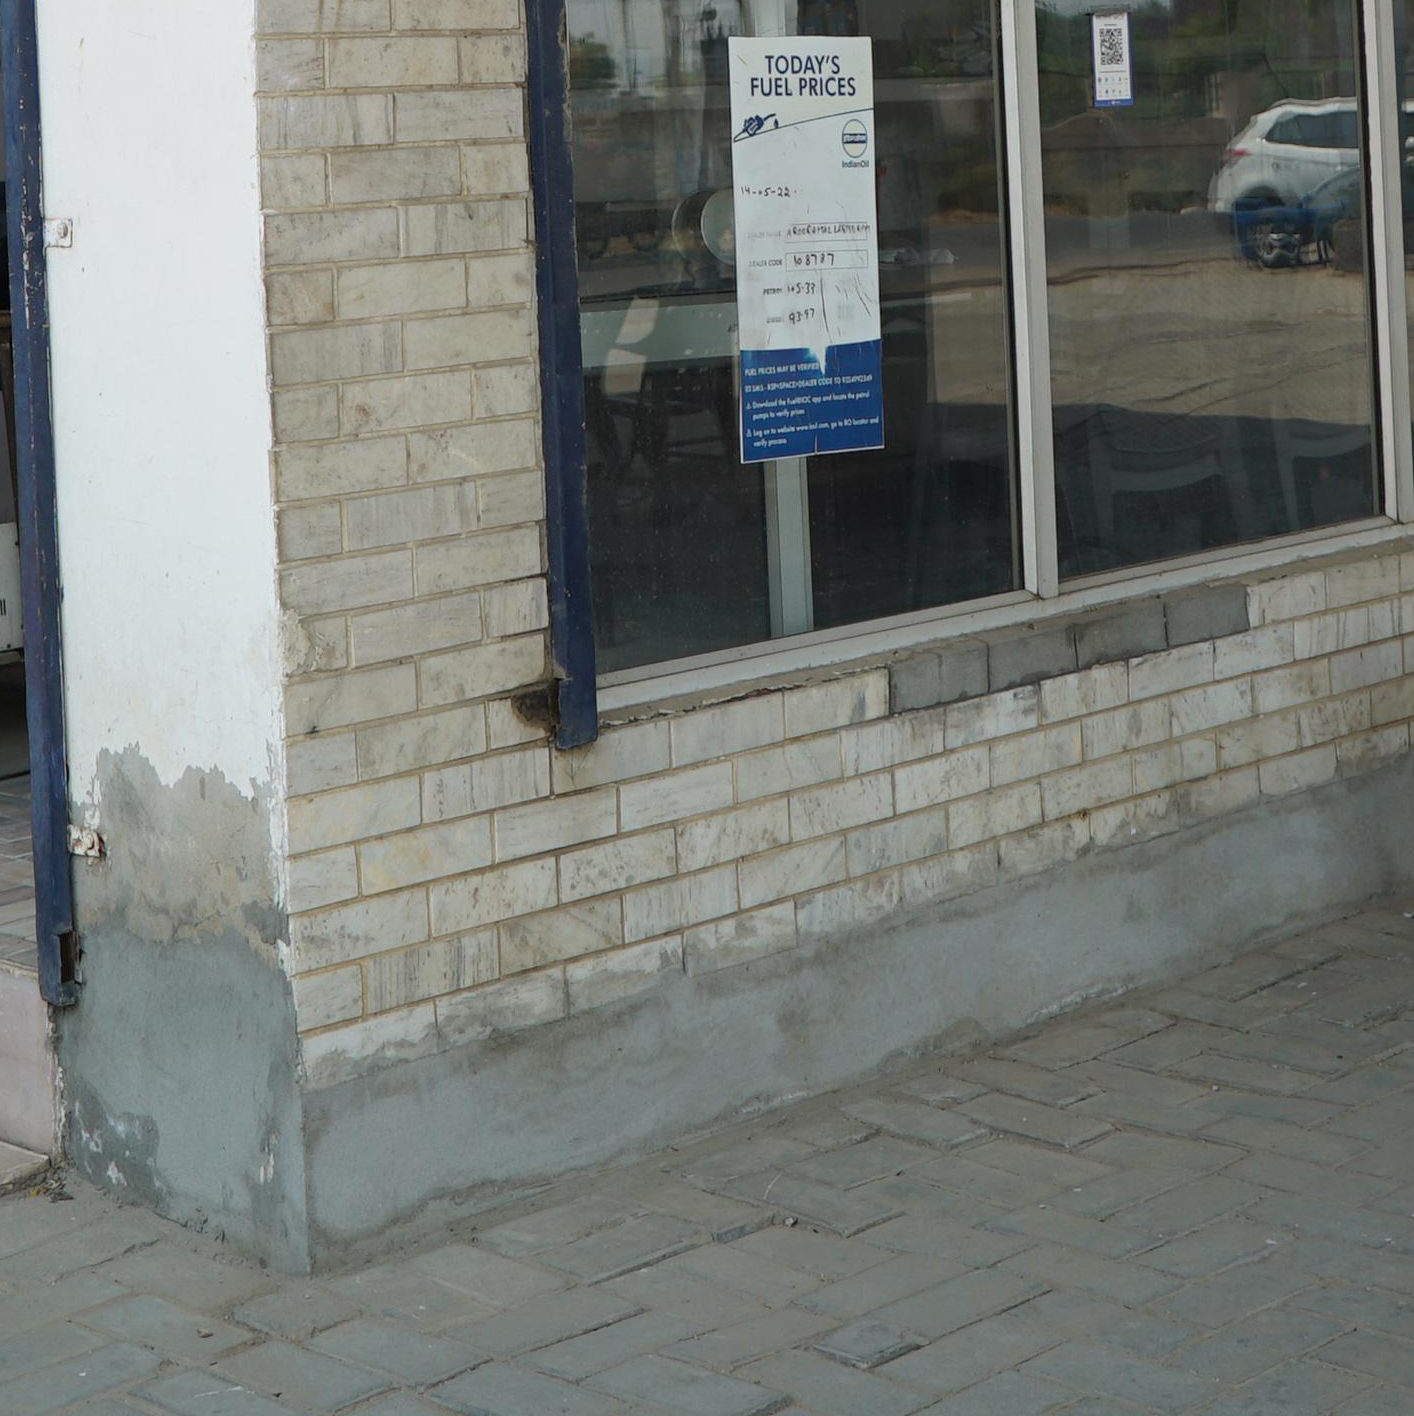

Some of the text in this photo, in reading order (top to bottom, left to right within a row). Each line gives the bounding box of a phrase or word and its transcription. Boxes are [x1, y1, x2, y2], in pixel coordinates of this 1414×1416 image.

[765, 55, 841, 75] TODAY'S
[750, 77, 857, 97] FUEL PRICES
[841, 159, 870, 168] IndianOil
[769, 258, 783, 266] CODE
[745, 367, 757, 377] FUEL
[758, 365, 776, 375] PRICES
[777, 364, 789, 373] MAY
[789, 364, 796, 372] BE
[818, 377, 833, 386] CODE
[847, 391, 855, 399] the
[855, 390, 870, 400] petrol
